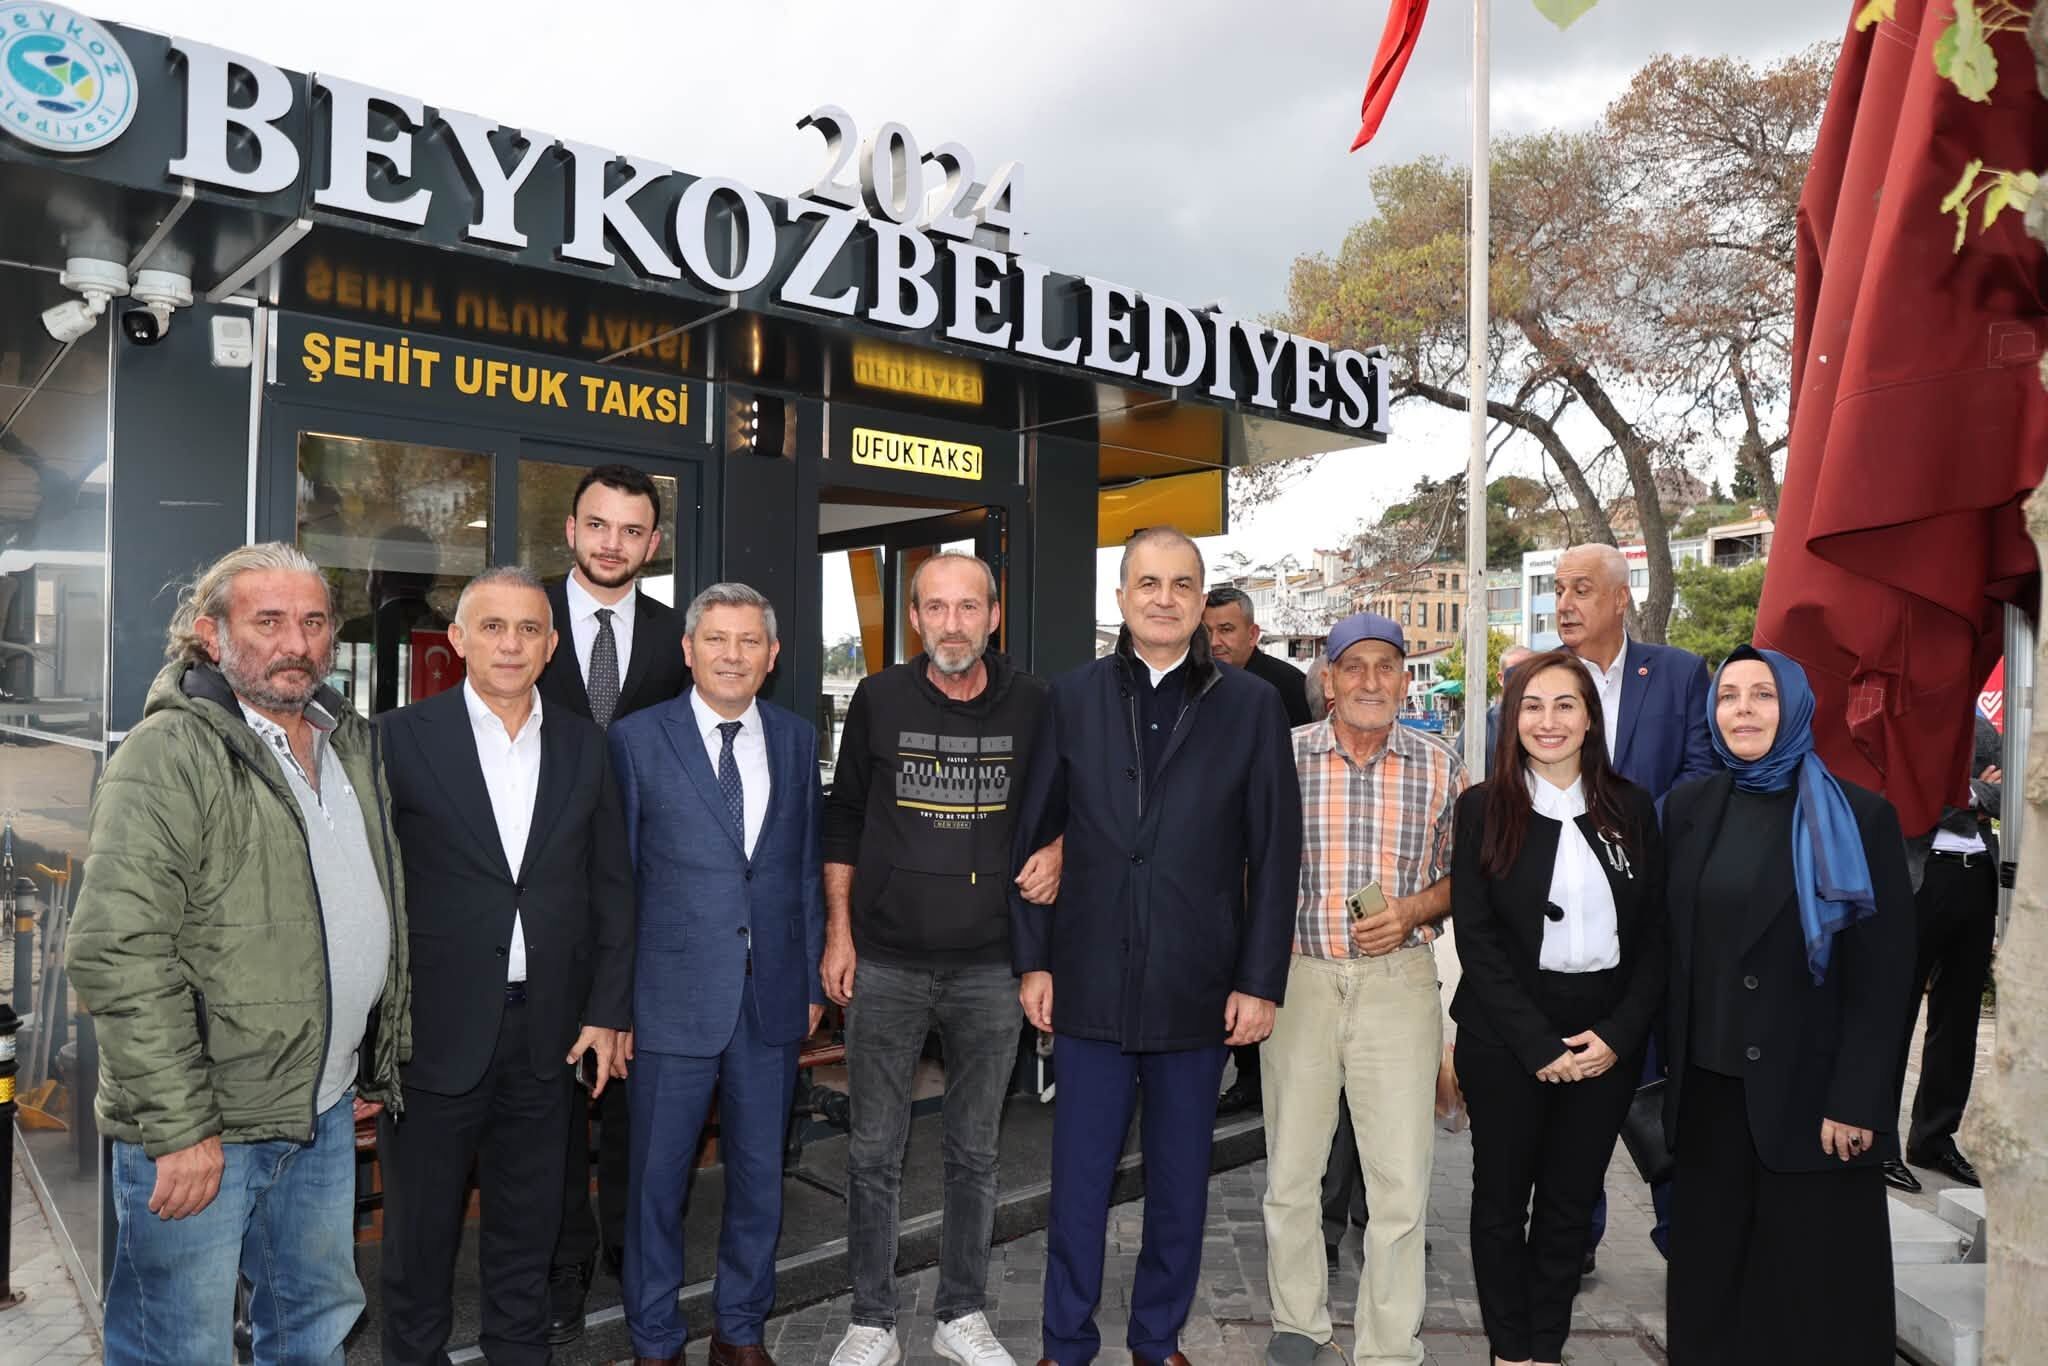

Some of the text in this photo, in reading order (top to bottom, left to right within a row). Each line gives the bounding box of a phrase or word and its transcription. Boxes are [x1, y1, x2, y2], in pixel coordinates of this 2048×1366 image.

[796, 104, 1026, 255] 2024
[302, 331, 690, 426] ŞEHİT UFUK TAKSİ
[856, 433, 980, 474] UFUKTAKSI
[902, 761, 1007, 791] RUNNING
